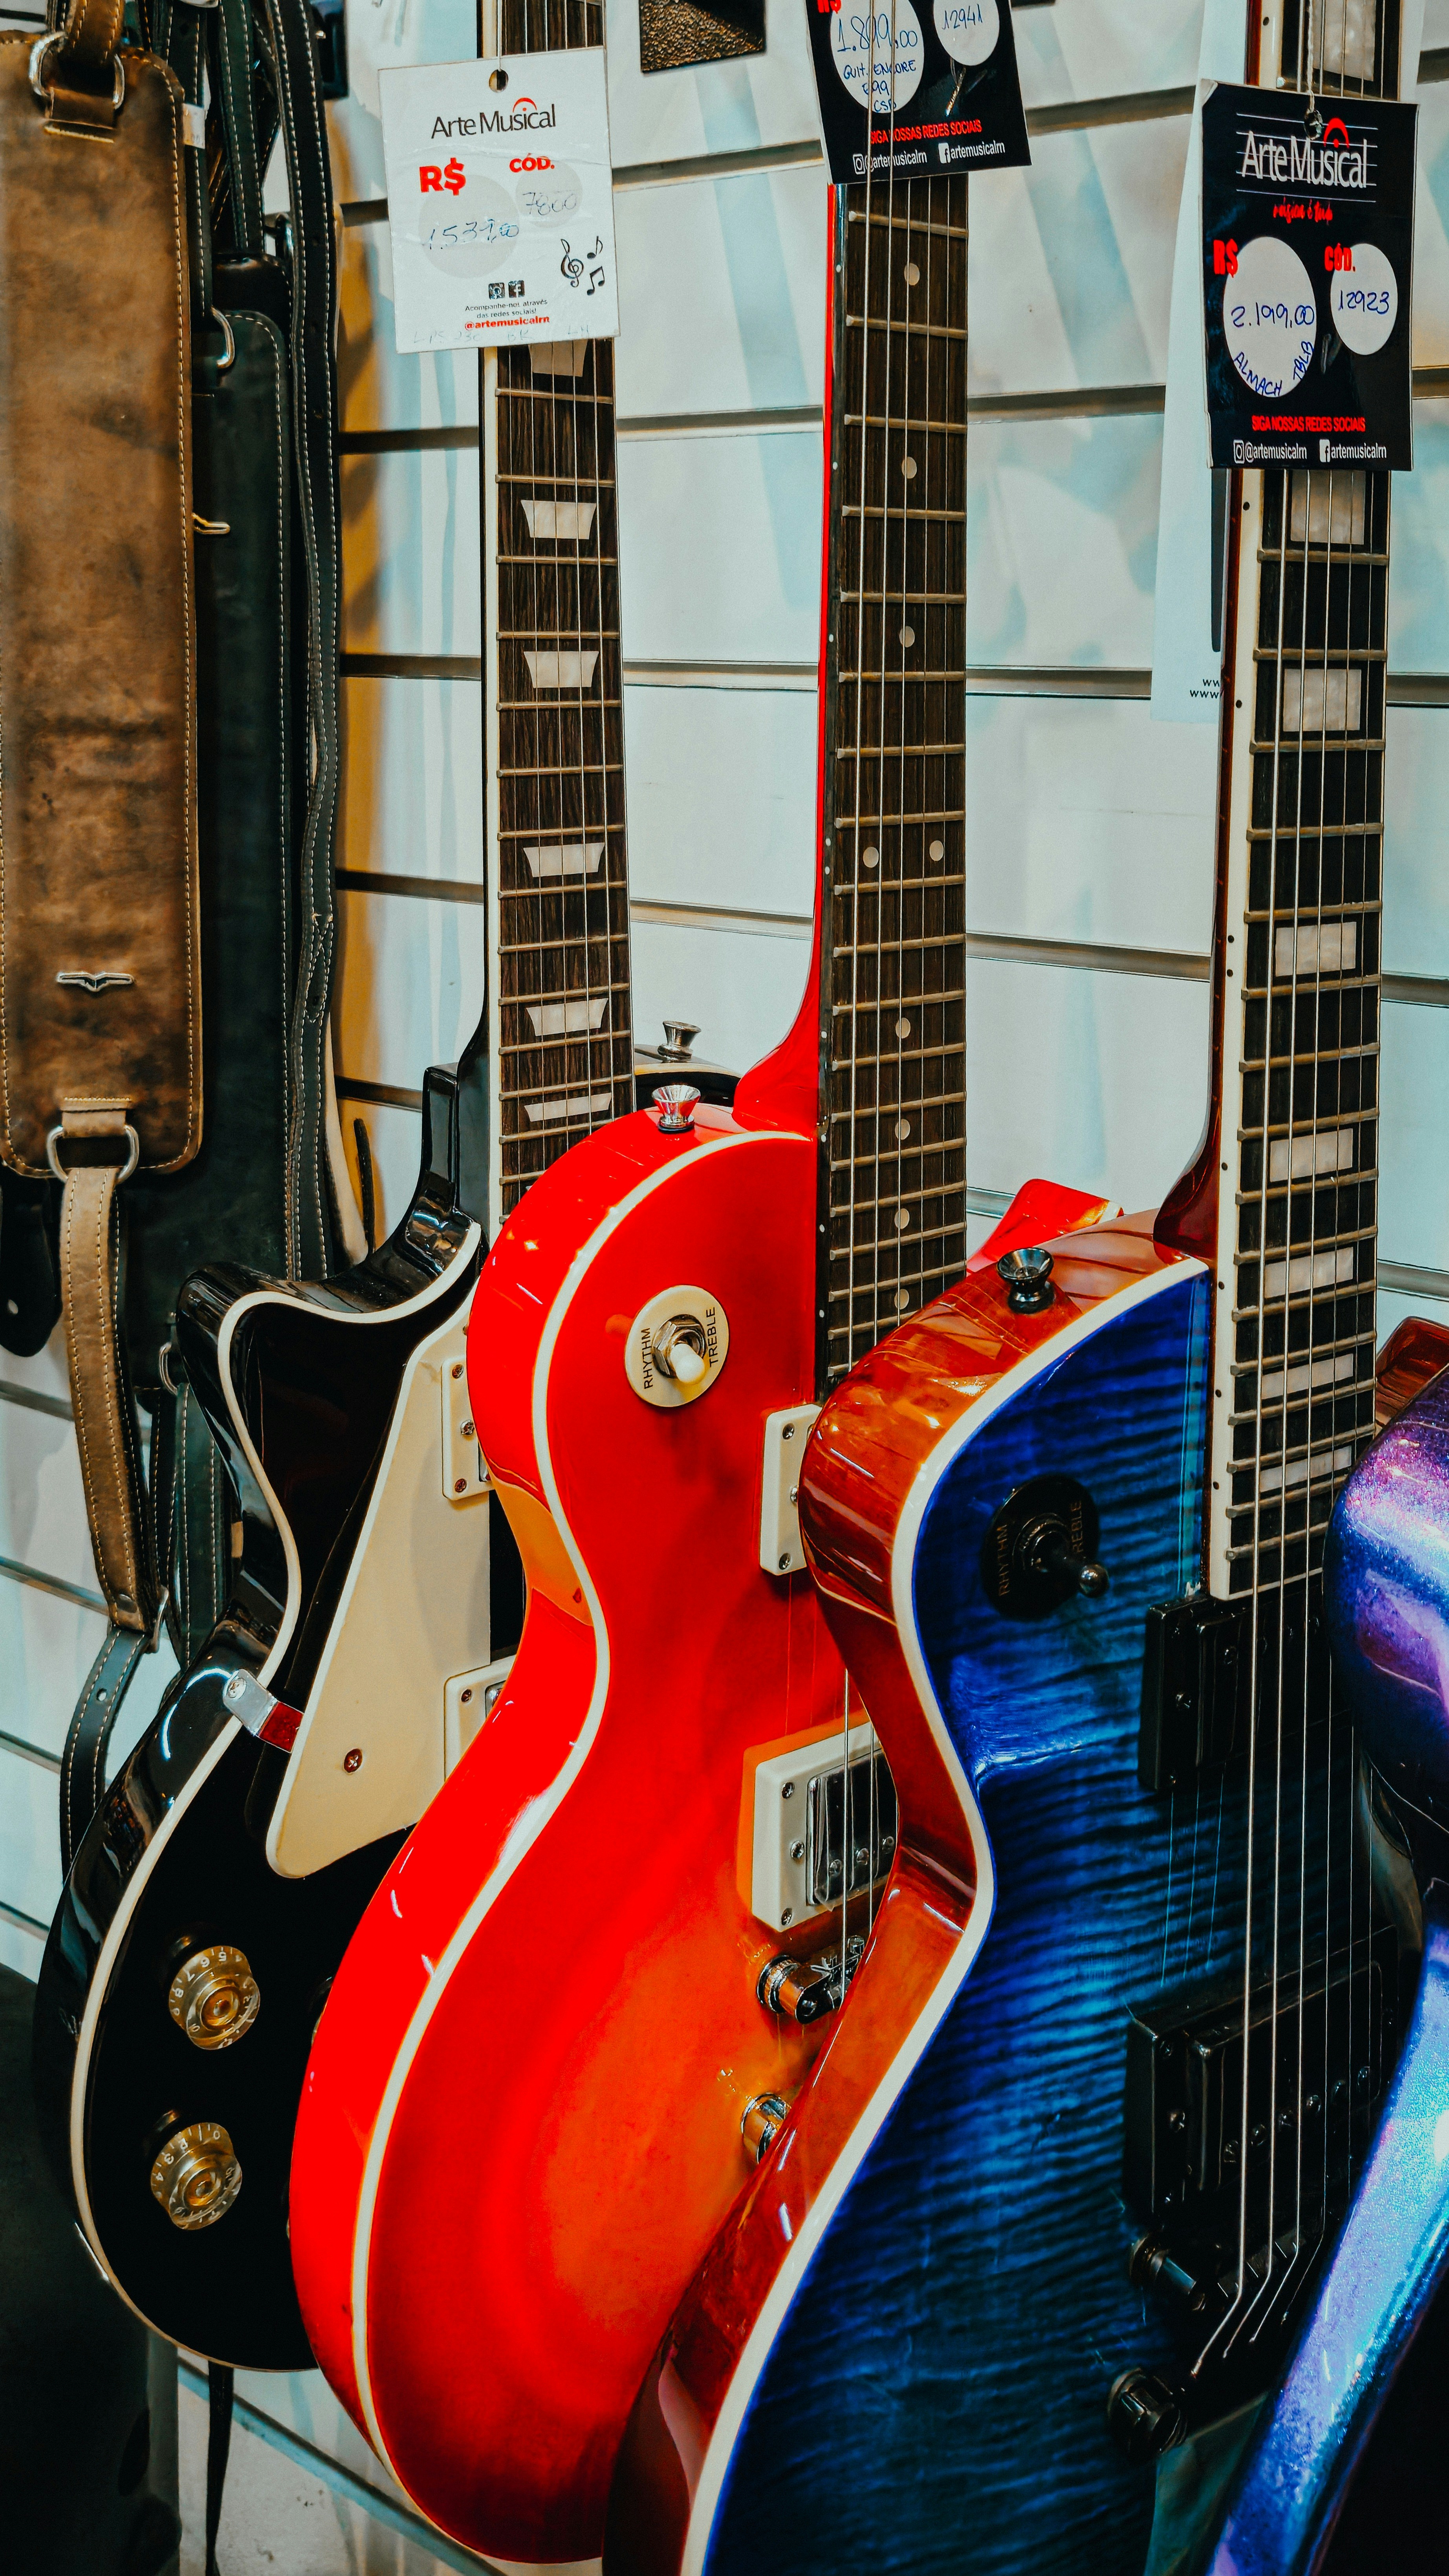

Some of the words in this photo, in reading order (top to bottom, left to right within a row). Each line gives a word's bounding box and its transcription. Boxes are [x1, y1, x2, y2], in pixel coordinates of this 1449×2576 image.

[837, 13, 918, 52] 1.899,00
[942, 4, 983, 30] 12941
[431, 116, 476, 139] Arte
[480, 104, 556, 134] Musical
[870, 130, 888, 144] SIGA
[922, 123, 949, 139] REDES
[951, 119, 982, 136] SOCIAIS
[419, 157, 466, 196] R$
[509, 153, 555, 172] CÓD.
[1242, 130, 1288, 182] Arte
[1291, 136, 1367, 188] Musical
[1213, 239, 1238, 278] R$
[1324, 242, 1356, 272] CÓD.
[1231, 302, 1315, 328] 2.199,00
[1338, 290, 1390, 314] 12923
[1233, 351, 1282, 396] ALMACH
[1251, 415, 1271, 431] SIGA
[1272, 416, 1304, 432] NOSSAS
[1305, 416, 1332, 432] REDES
[1334, 416, 1366, 432] SOCIAIS
[706, 1307, 719, 1367] TREBLE
[641, 1328, 653, 1389] RHYTHM
[1070, 1501, 1085, 1554] REBLE
